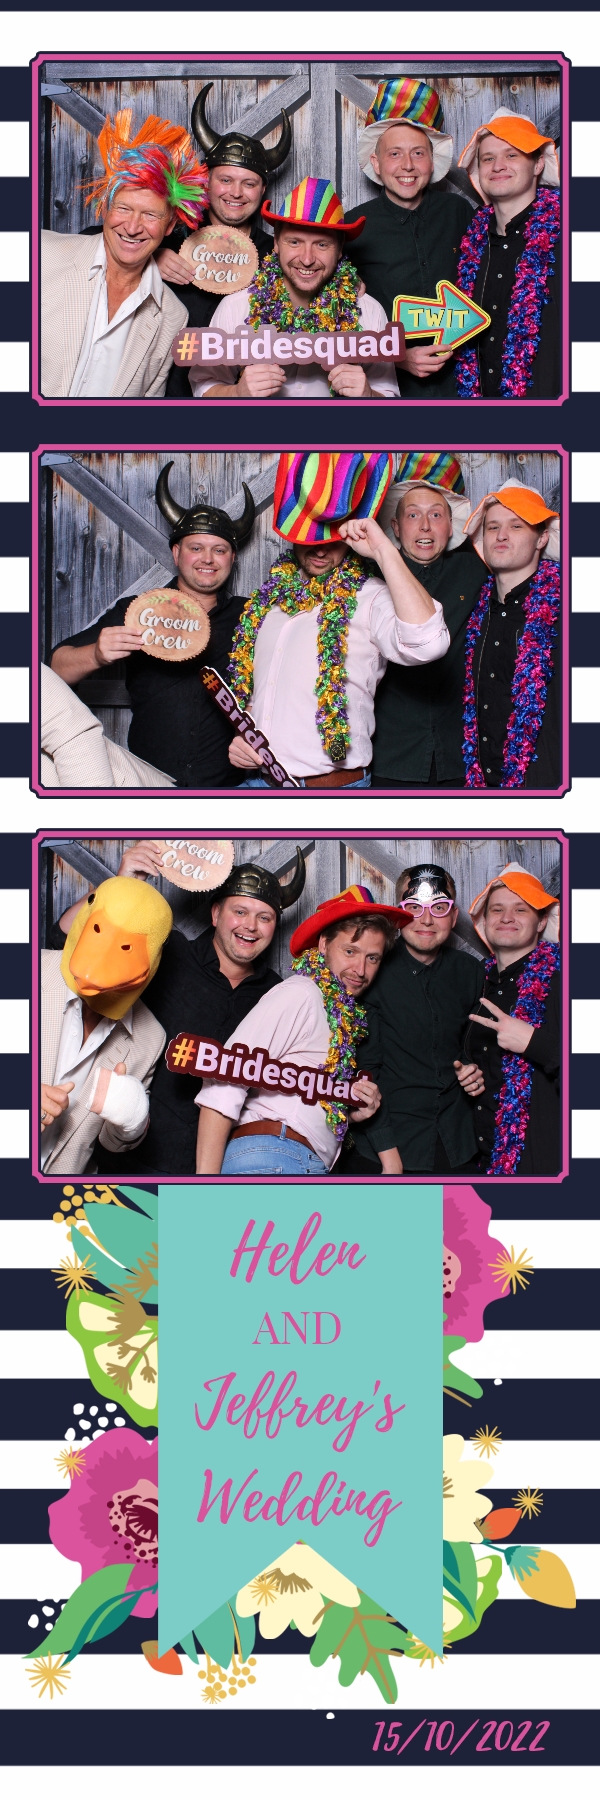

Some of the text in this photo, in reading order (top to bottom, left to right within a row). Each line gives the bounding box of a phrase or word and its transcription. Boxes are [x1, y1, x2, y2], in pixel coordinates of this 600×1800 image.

[192, 244, 250, 264] Groom
[194, 263, 242, 283] Crew
[407, 308, 470, 329] TWIT
[176, 326, 401, 365] #Bridesquad
[139, 607, 201, 631] Groom
[141, 628, 193, 649] Crew
[161, 850, 210, 880] Crew
